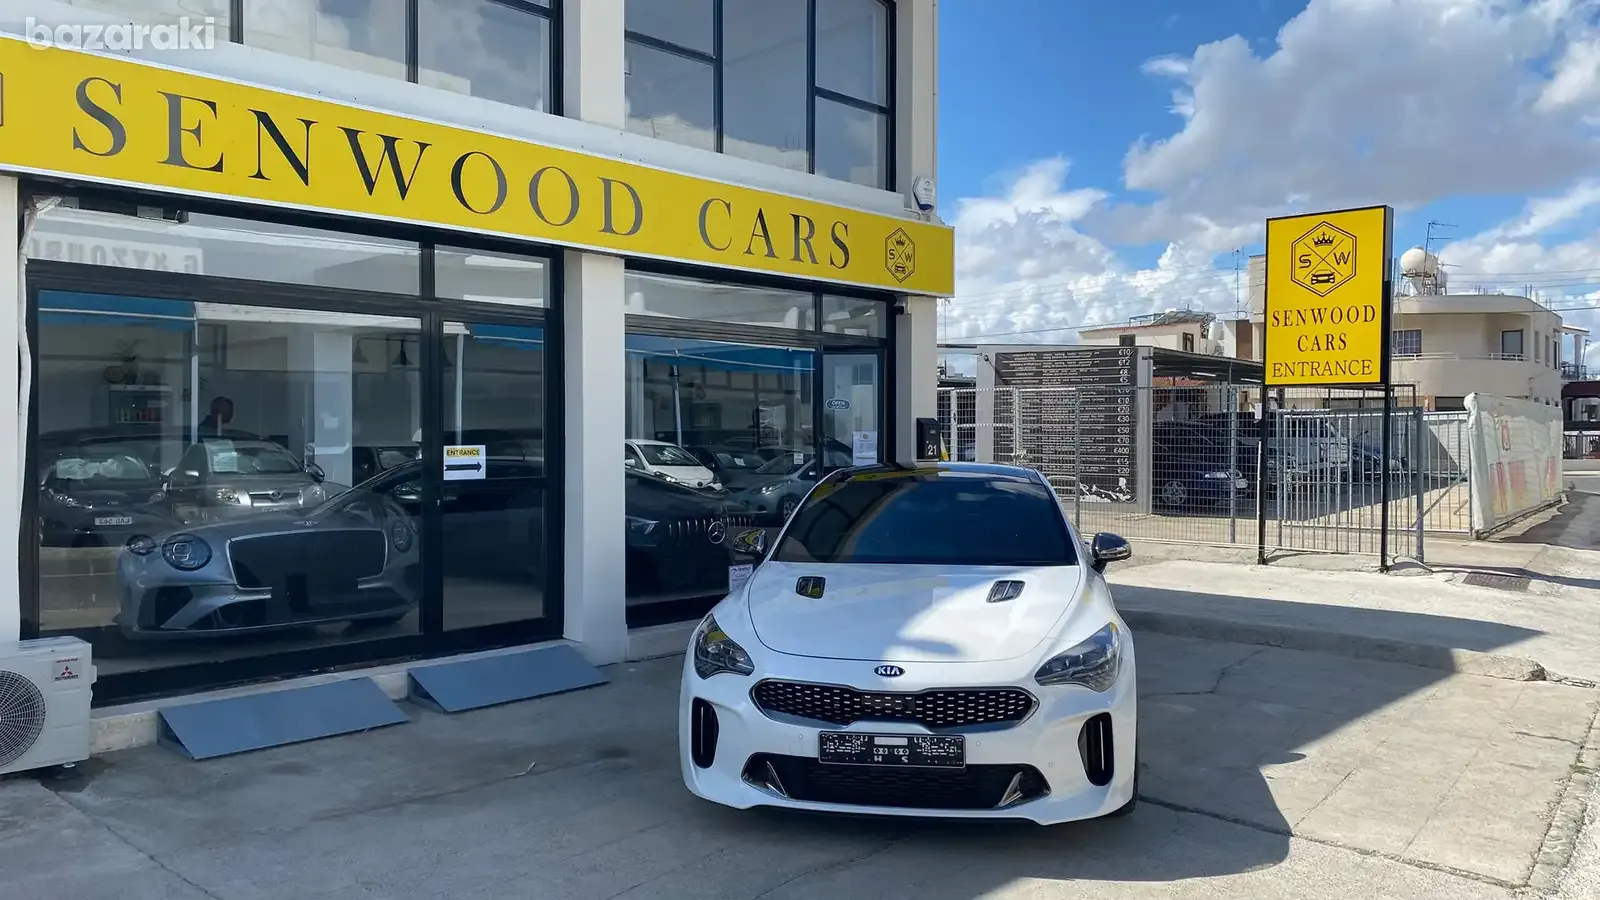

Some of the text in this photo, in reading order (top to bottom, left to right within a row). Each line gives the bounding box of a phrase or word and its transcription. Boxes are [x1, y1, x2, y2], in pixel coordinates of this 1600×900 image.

[72, 76, 851, 270] SENWOOD CARS
[888, 248, 913, 263] S W
[1271, 304, 1376, 328] SENWOOD
[1297, 332, 1347, 353] CARS
[1118, 348, 1131, 356] €10
[1272, 359, 1373, 378] ENTRANCE
[446, 448, 480, 456] ENTRANCE
[927, 444, 937, 456] 21
[877, 666, 900, 676] KIA
